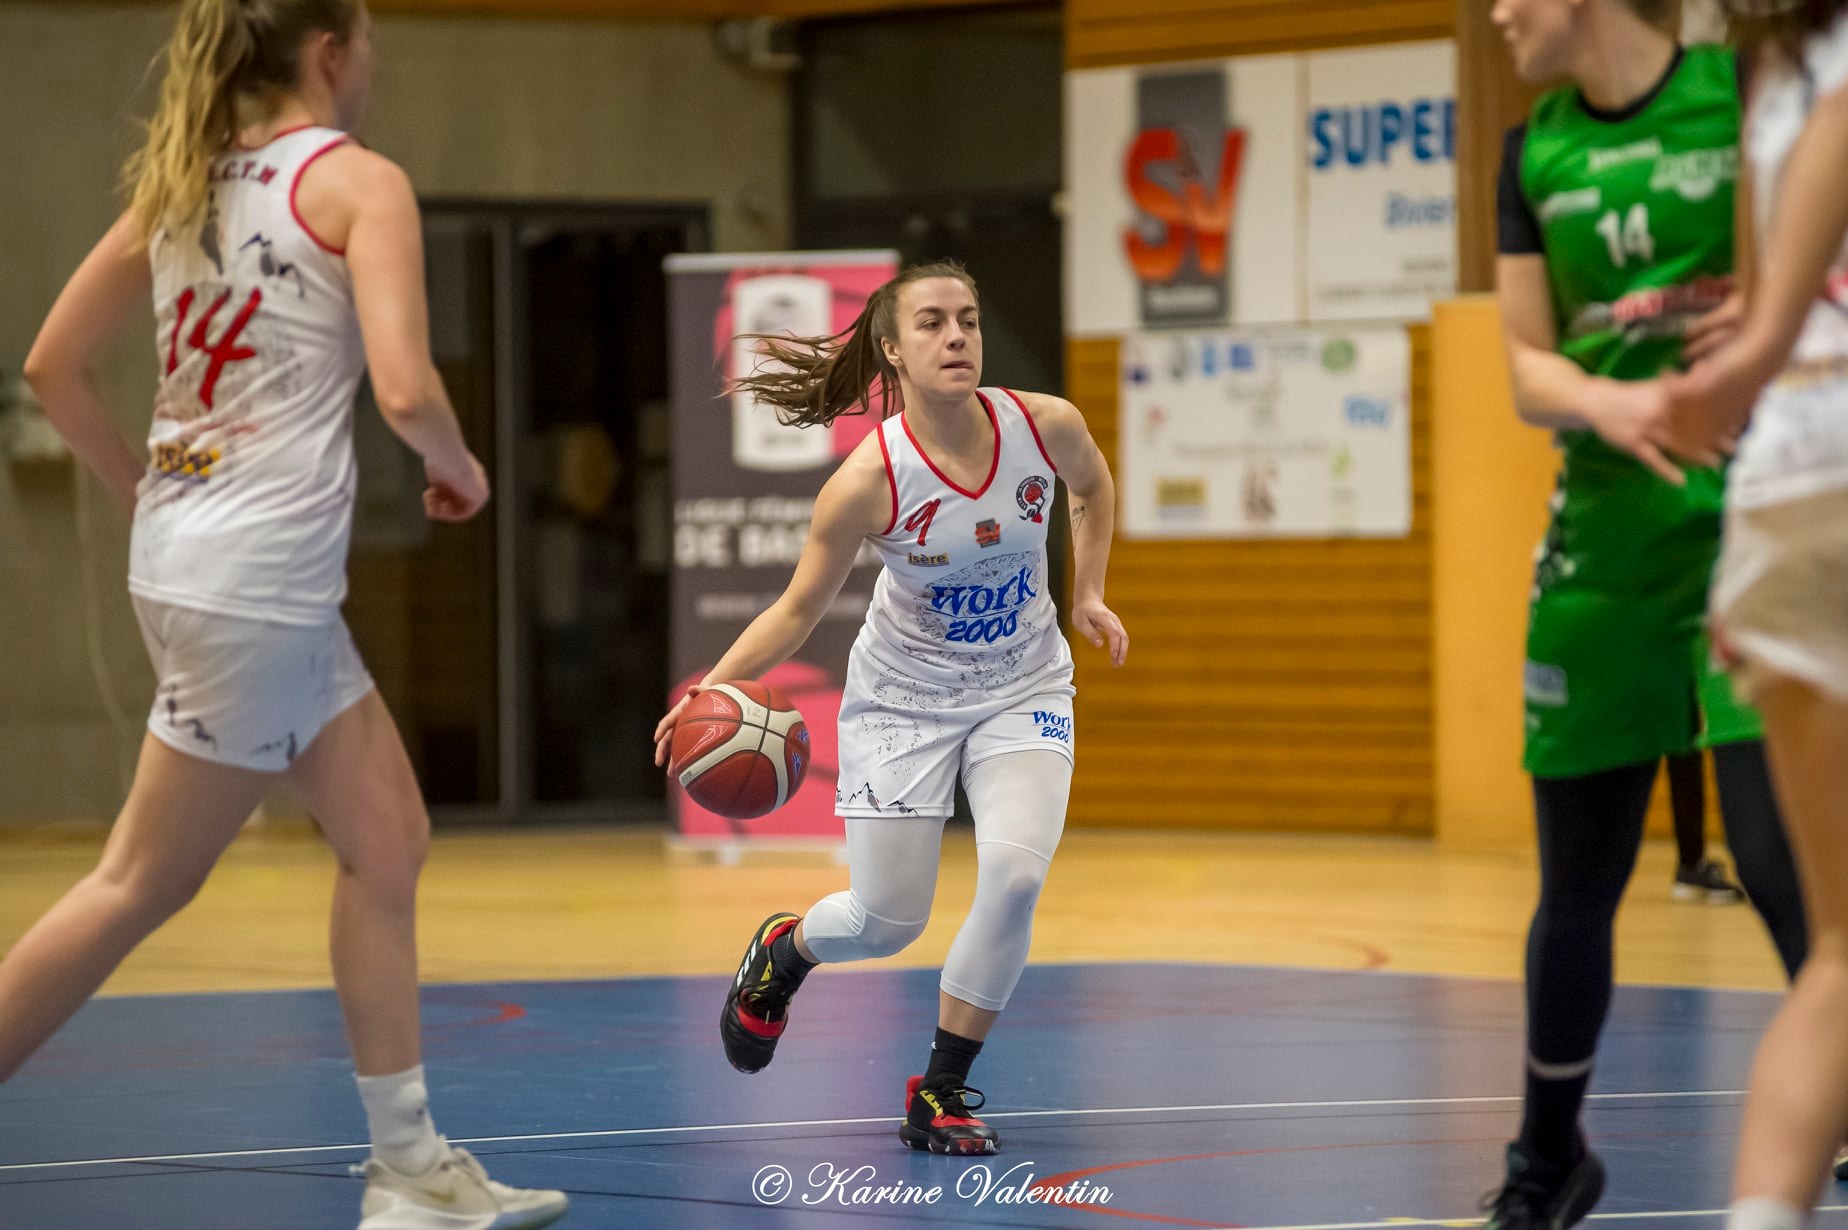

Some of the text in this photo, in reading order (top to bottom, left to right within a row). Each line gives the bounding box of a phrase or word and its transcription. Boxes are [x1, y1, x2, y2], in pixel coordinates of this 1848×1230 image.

[1595, 202, 1655, 269] 14
[166, 287, 262, 411] 14
[904, 498, 942, 546] 9
[908, 552, 947, 565] isère
[945, 609, 1019, 644] 2000
[1041, 726, 1070, 744] 2000
